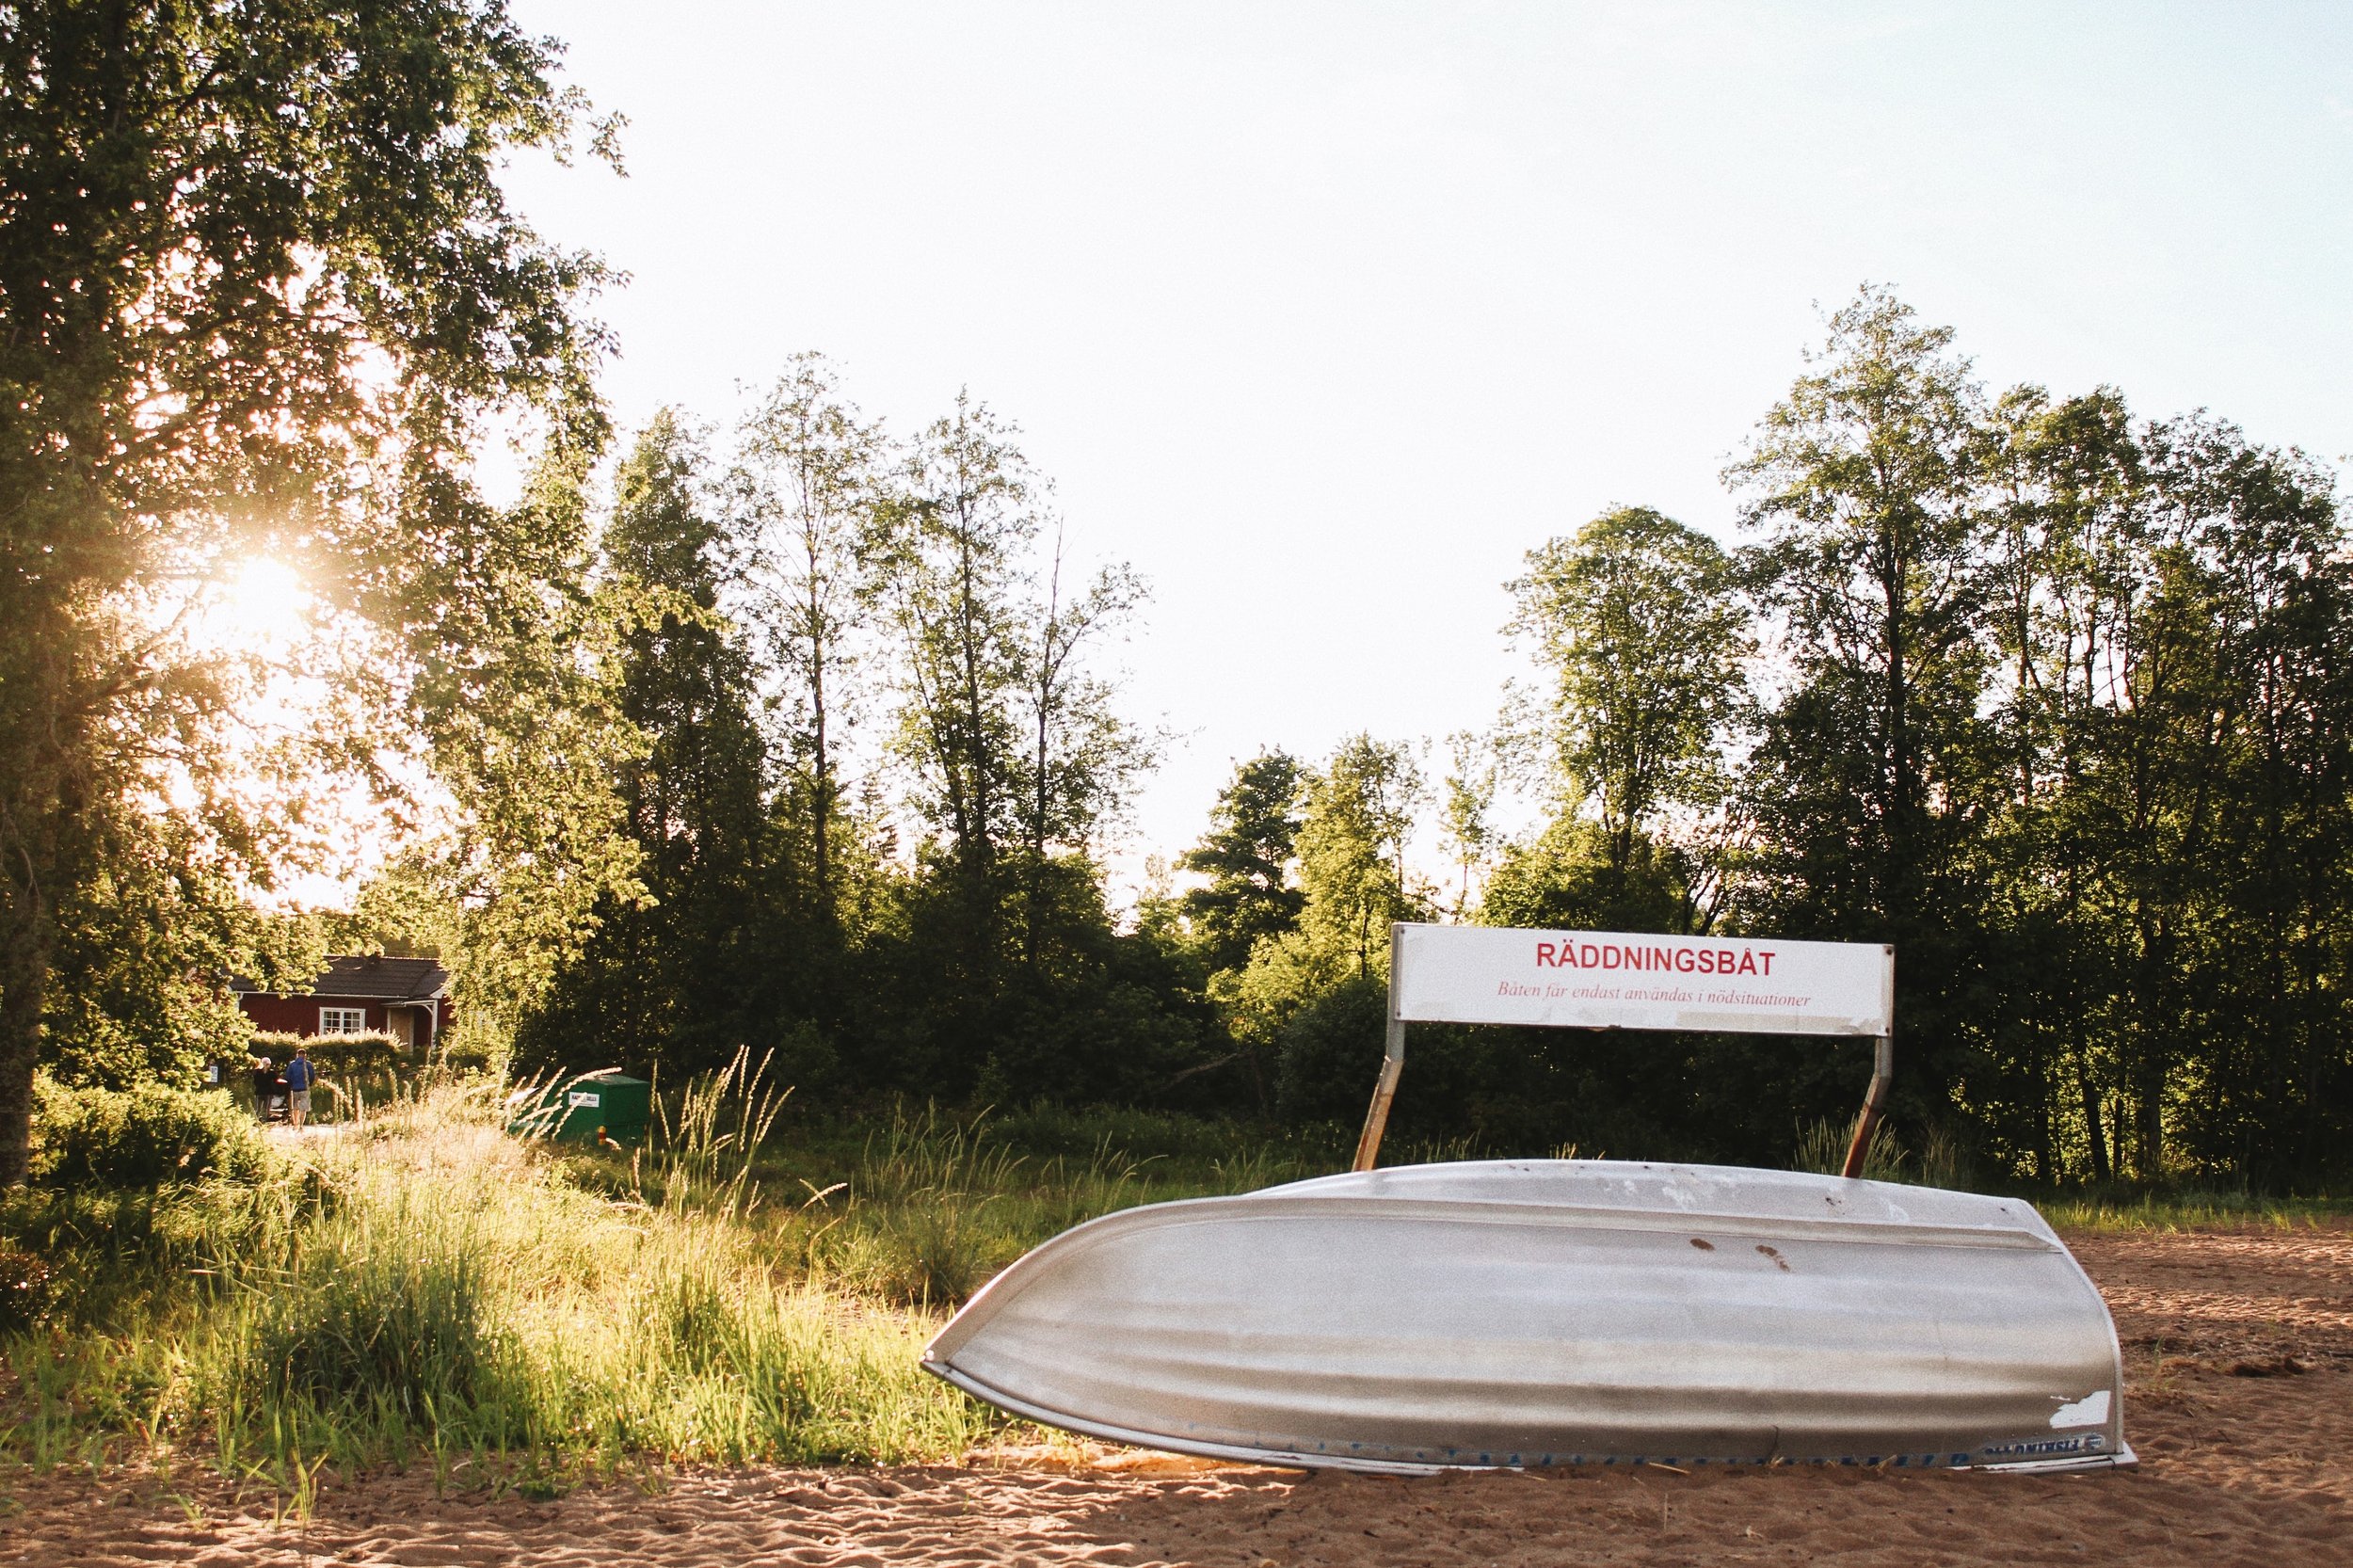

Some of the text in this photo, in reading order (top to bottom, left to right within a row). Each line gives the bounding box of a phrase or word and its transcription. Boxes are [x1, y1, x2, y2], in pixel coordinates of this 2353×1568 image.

[1537, 939, 1776, 976] RÄDDNINGSBÅT
[1497, 981, 1811, 1006] Båten får endast användas i nödsituationer
